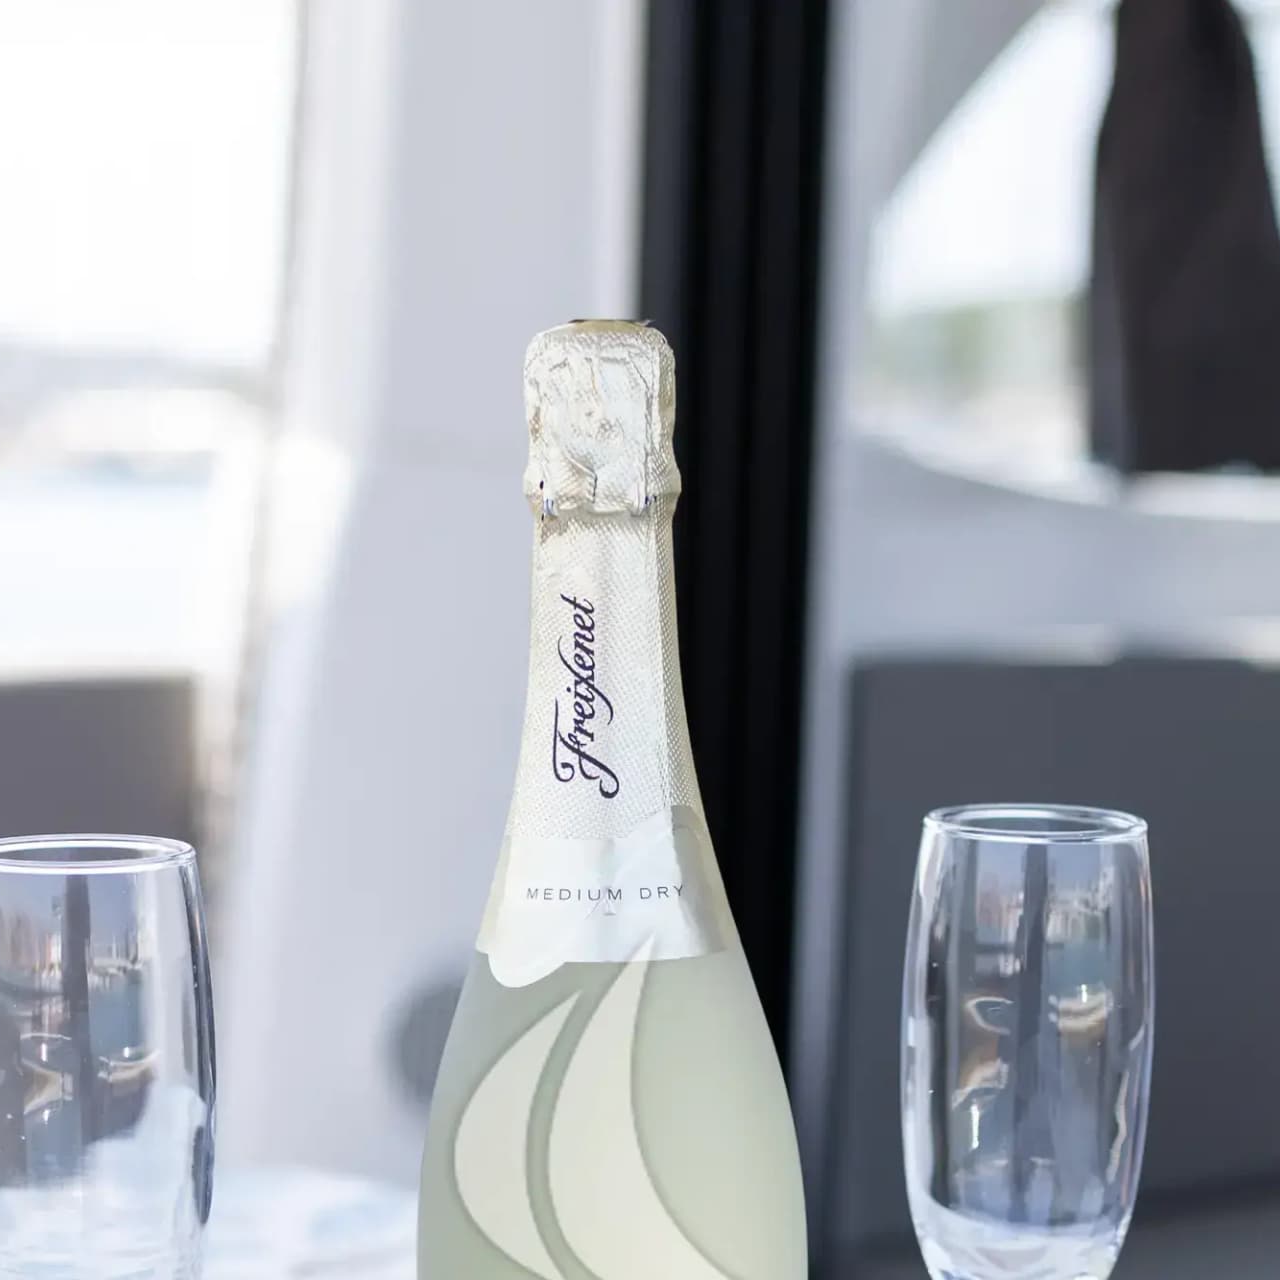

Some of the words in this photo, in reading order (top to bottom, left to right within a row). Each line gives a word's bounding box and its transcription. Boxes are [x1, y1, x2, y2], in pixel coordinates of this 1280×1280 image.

[552, 593, 620, 799] Freixenet
[526, 888, 623, 901] MEDIUM
[639, 885, 684, 900] DRY
